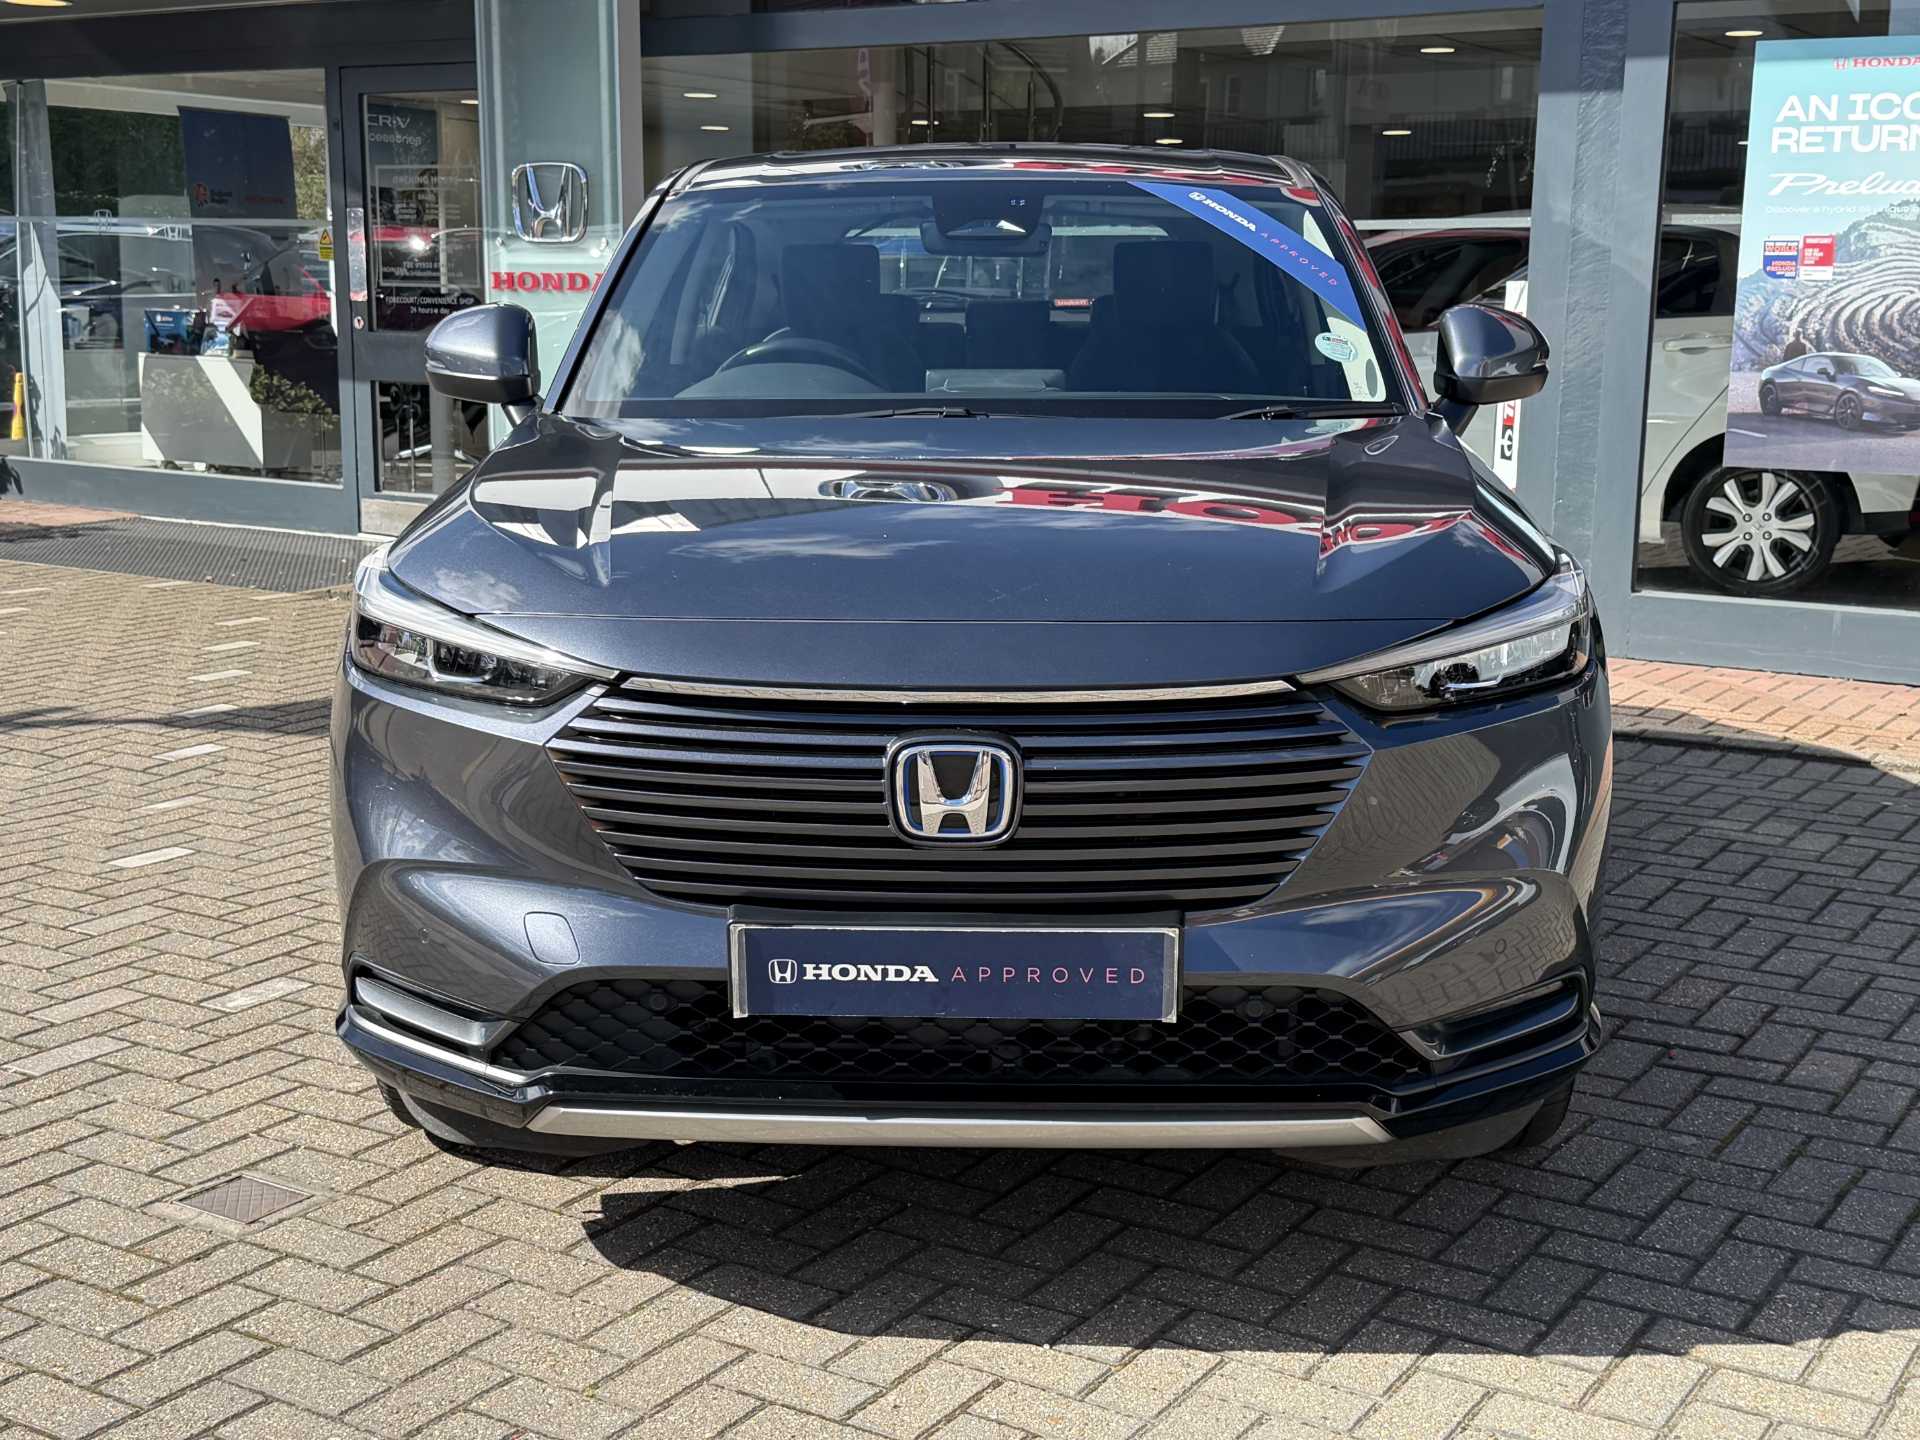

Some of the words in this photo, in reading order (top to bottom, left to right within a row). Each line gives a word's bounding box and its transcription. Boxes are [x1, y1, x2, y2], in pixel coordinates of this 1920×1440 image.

[1775, 94, 1839, 122] AN
[1202, 198, 1256, 233] HONDA
[1260, 232, 1338, 287] APPROVED
[802, 963, 939, 983] HONDA
[951, 965, 1146, 984] APPROVED
